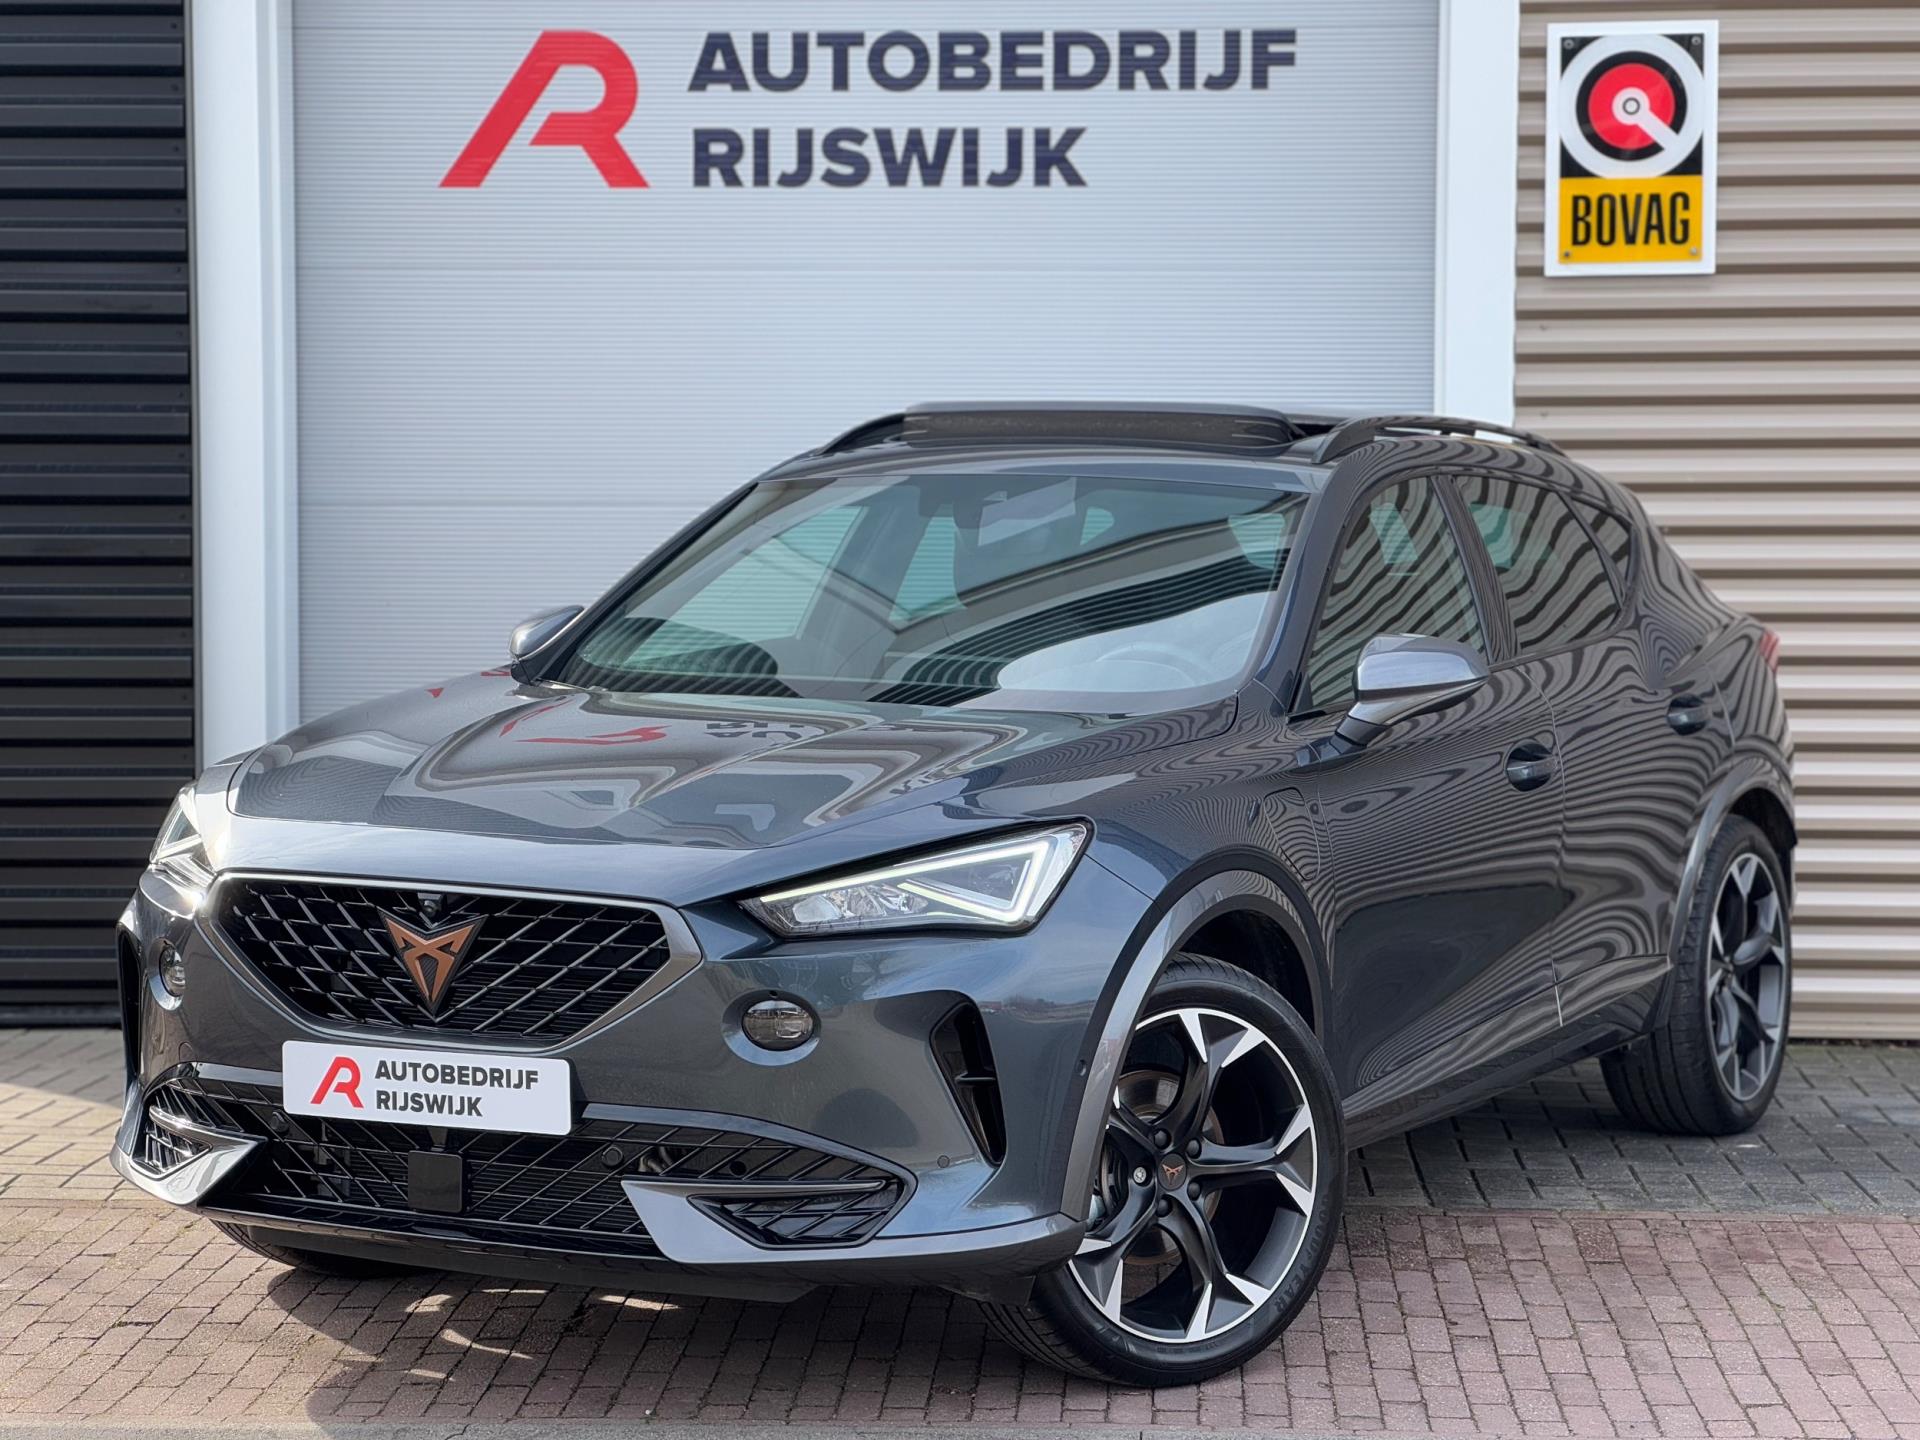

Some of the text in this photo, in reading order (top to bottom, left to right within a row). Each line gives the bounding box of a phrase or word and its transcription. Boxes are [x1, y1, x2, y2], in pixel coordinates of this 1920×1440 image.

[687, 29, 1297, 92] AUTOBEDRIJF
[693, 128, 1088, 188] RIJSWIJK
[1572, 192, 1690, 246] BOVAG
[375, 1060, 539, 1090] AUTOBEDRIJF
[376, 1090, 483, 1117] RIJSWIJK
